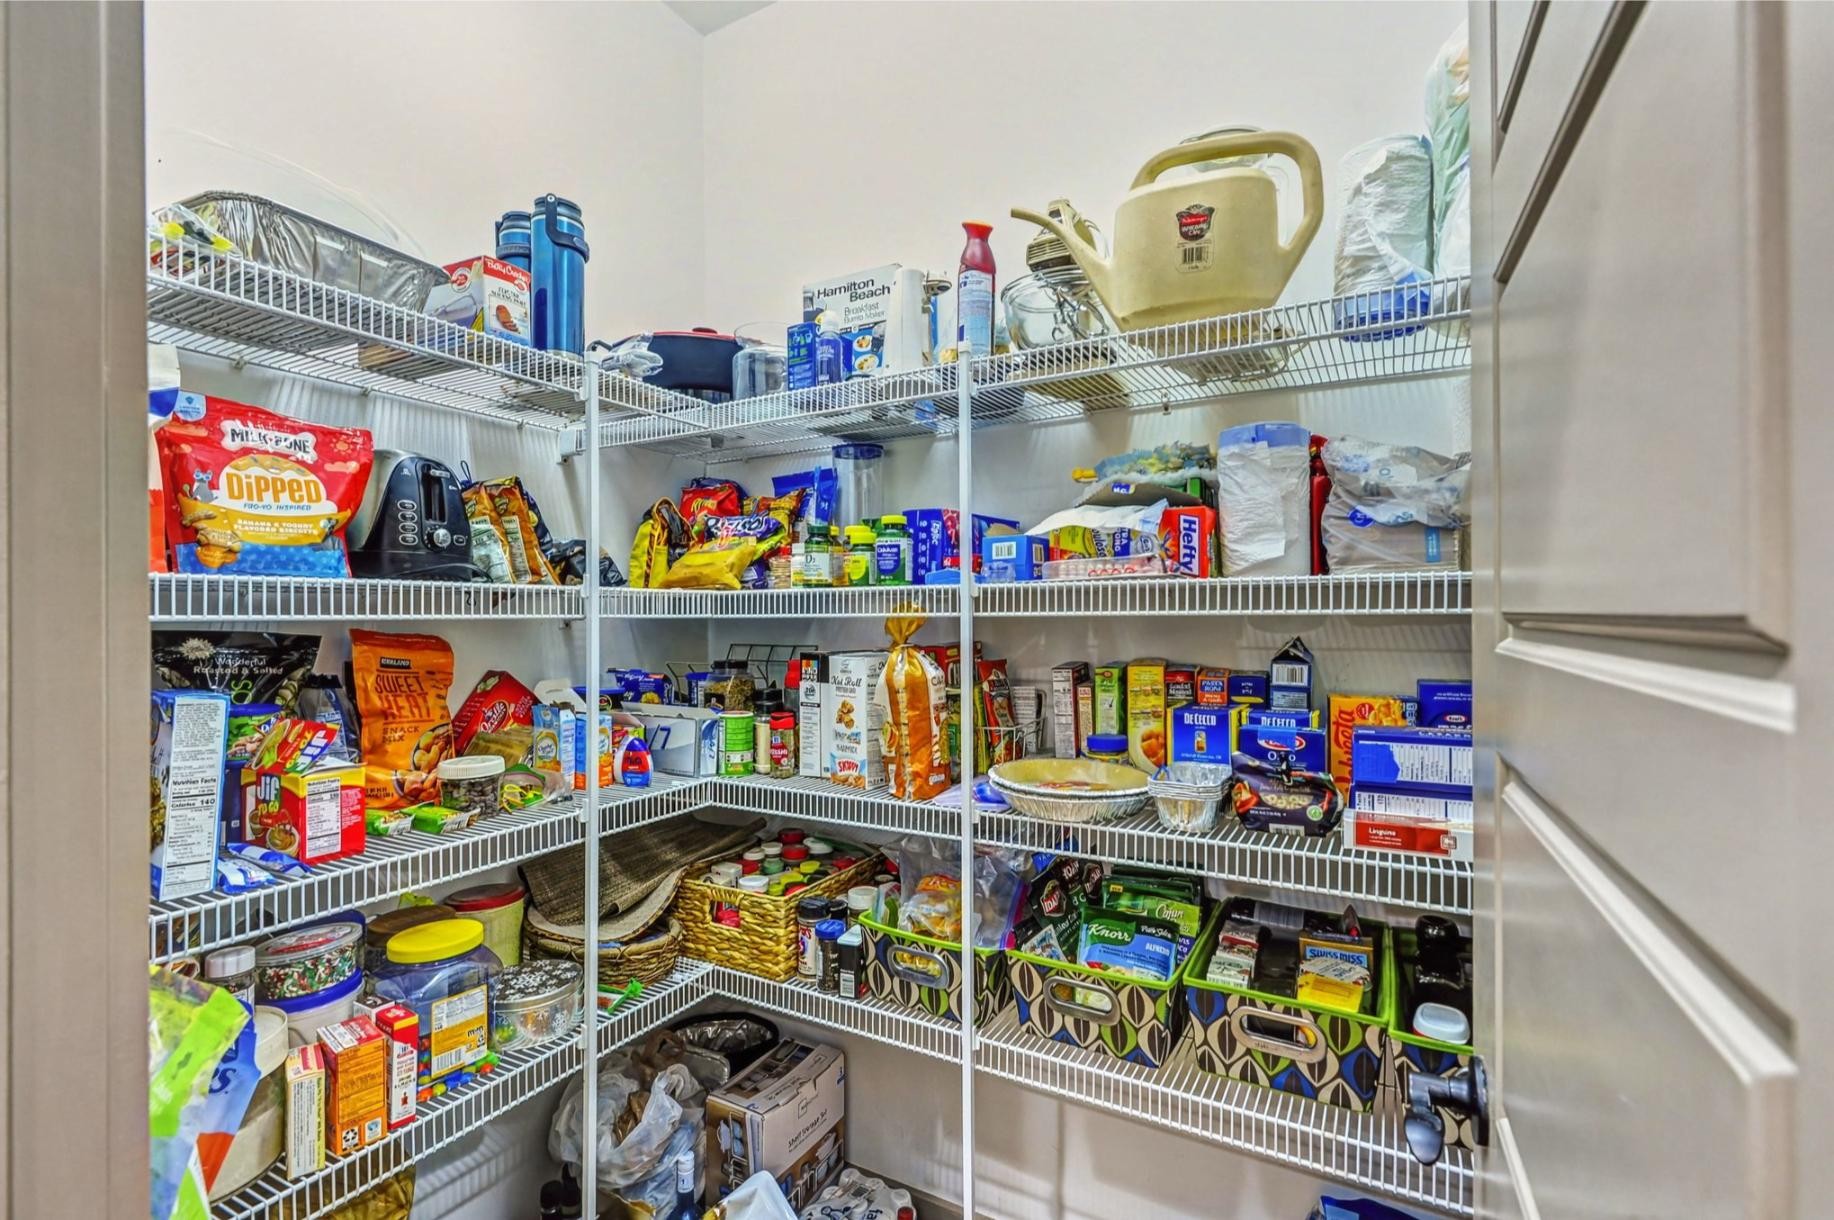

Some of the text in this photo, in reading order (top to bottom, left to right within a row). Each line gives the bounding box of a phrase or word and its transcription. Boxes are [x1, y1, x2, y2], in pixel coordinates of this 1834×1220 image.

[817, 278, 875, 299] Hamilton
[849, 284, 891, 302] Beach
[1180, 517, 1199, 572] Hefty
[375, 674, 425, 694] SWEET
[257, 774, 280, 801] Jif
[1155, 903, 1185, 920] Cajun
[1088, 922, 1133, 942] Knorr
